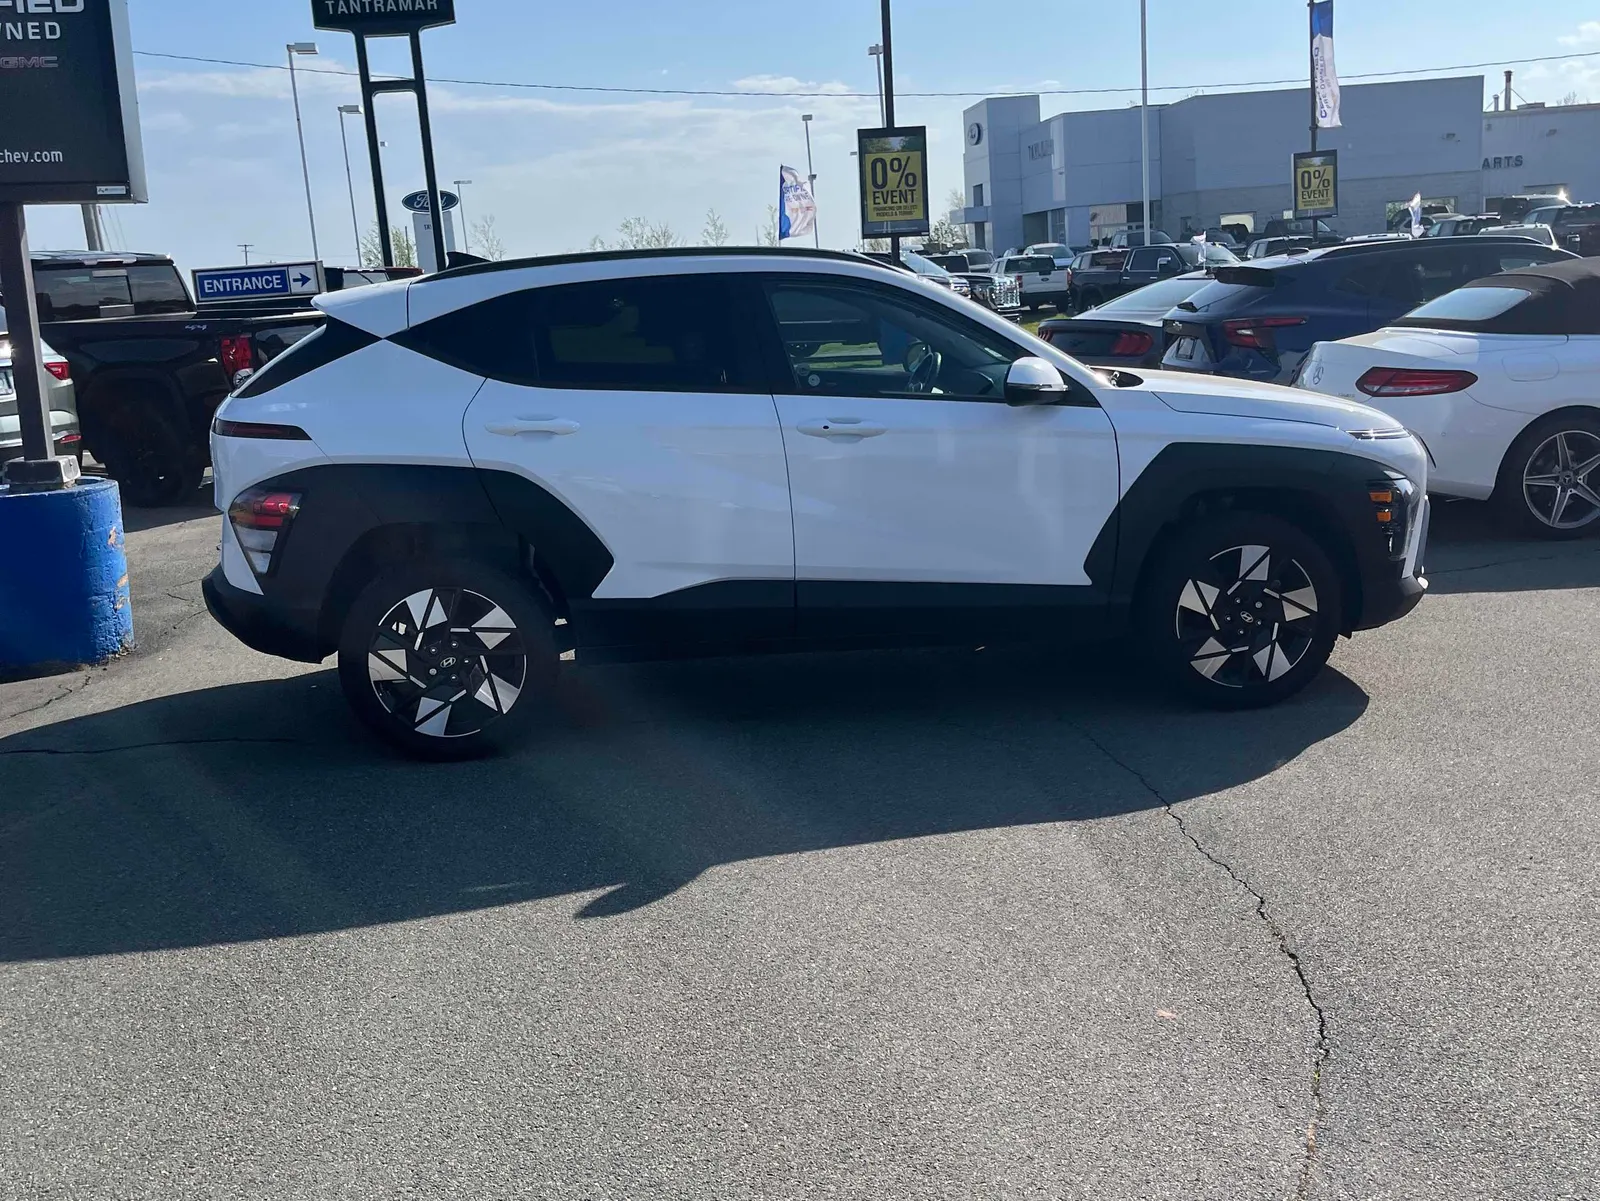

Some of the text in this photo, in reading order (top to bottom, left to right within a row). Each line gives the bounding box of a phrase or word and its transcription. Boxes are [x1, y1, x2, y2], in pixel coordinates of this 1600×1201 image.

[325, 0, 438, 15] TANTRAMAR
[0, 21, 61, 40] NED
[0, 56, 58, 69] GMC
[1482, 155, 1524, 170] ARTS
[870, 156, 917, 190] 0%
[1300, 168, 1331, 190] 0%
[872, 189, 917, 206] EVENT
[1301, 189, 1330, 201] EVENT
[203, 275, 283, 293] ENTRANCE
